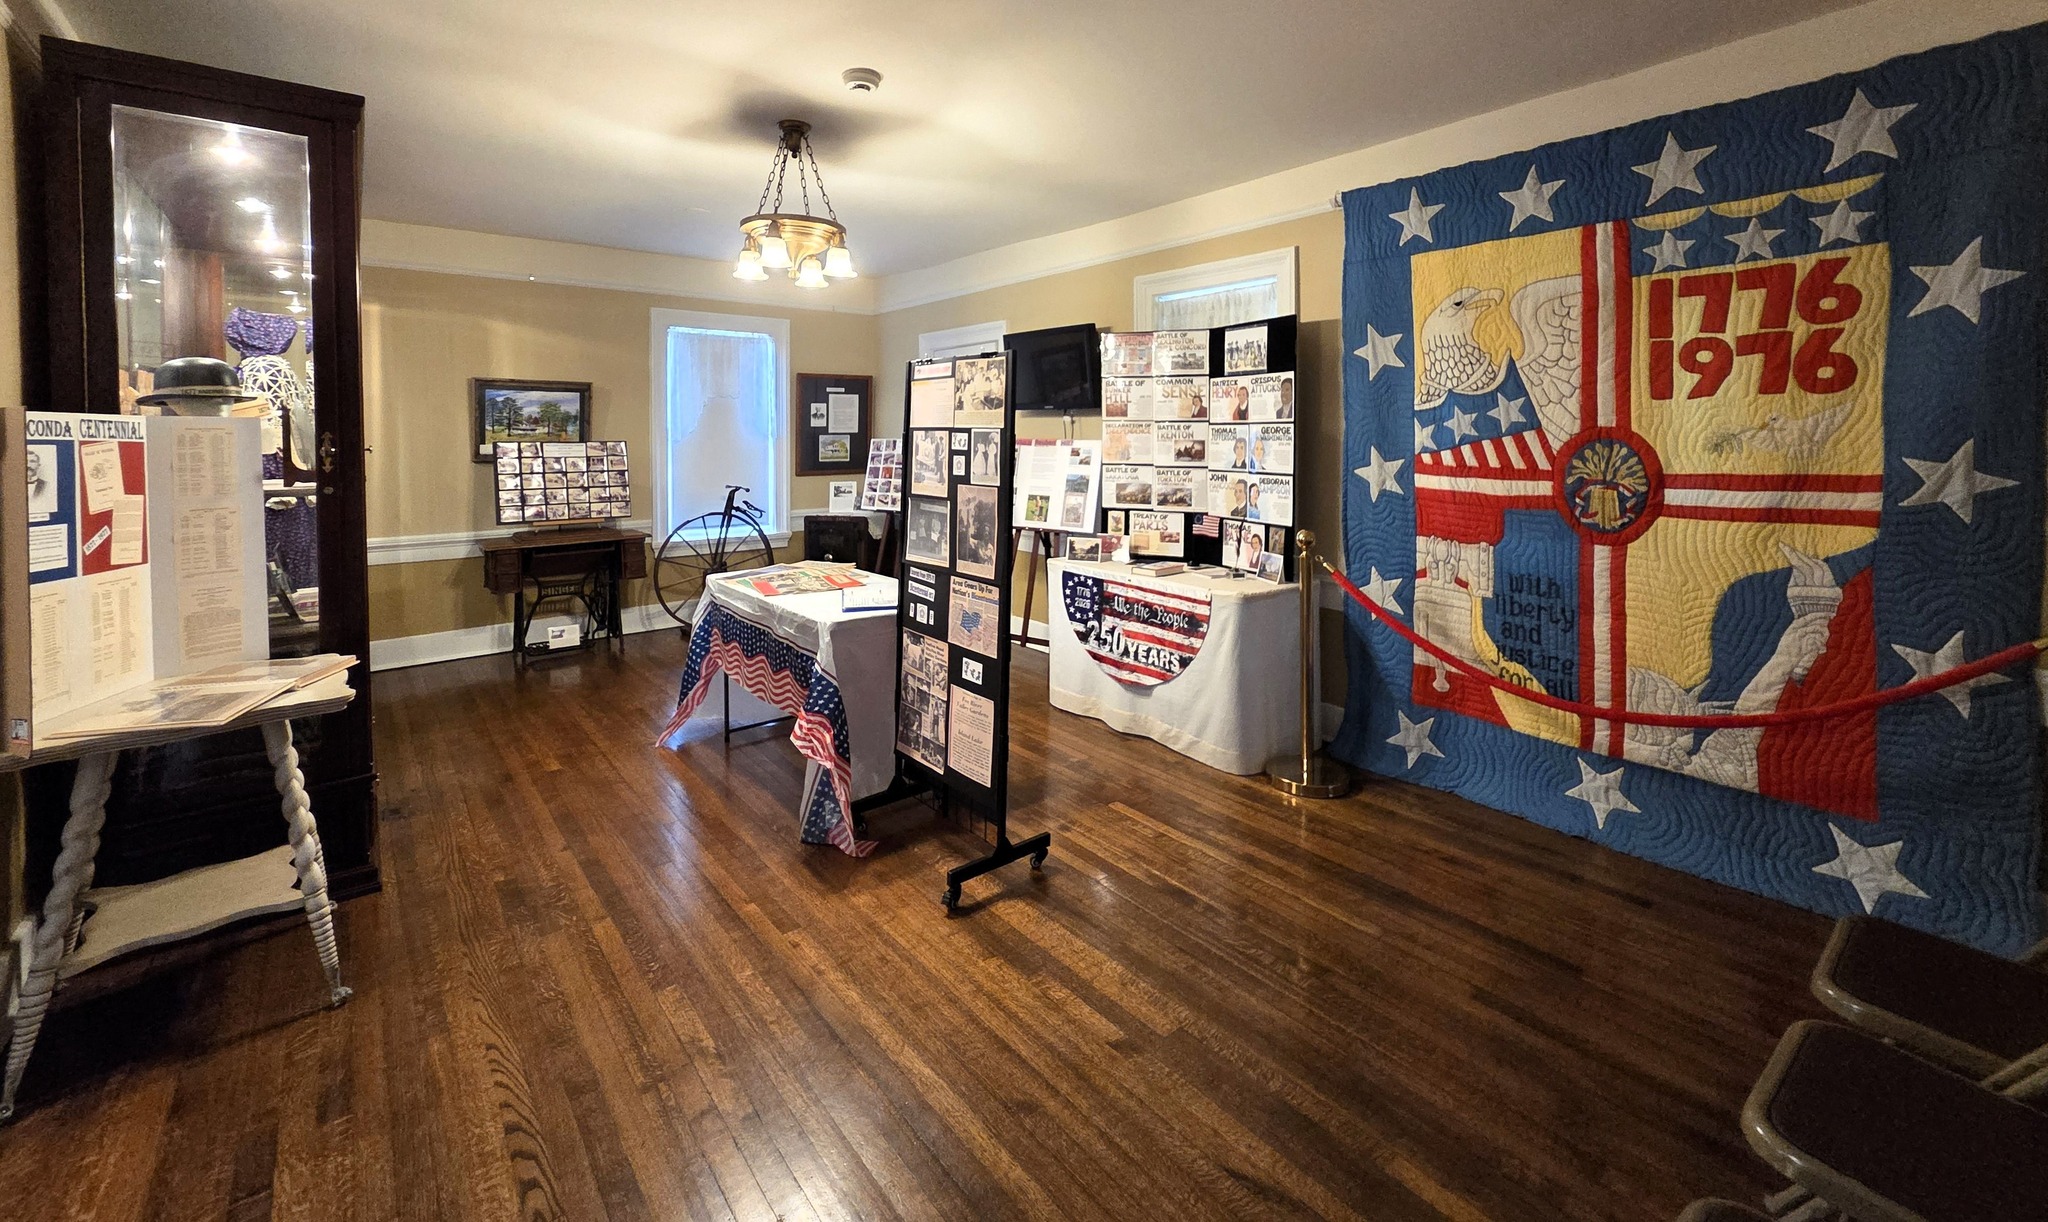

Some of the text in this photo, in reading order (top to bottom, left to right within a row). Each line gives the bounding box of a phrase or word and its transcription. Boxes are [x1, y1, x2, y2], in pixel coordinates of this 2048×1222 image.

[1648, 257, 1862, 338] 1776
[1648, 327, 1859, 401] 1976
[1155, 378, 1194, 386] COMMON
[1250, 376, 1281, 384] CRISPUS
[1105, 393, 1132, 403] HILL
[1162, 384, 1206, 398] SENSE
[1212, 386, 1238, 399] HENRY
[79, 418, 144, 439] CENTENNIAL
[1261, 426, 1291, 435] GEORGE
[1209, 473, 1228, 482] JOHN
[1259, 478, 1290, 486] DEBORAH
[1133, 520, 1169, 531] PARIS
[952, 578, 963, 587] Area
[978, 583, 985, 593] Up
[1076, 586, 1091, 598] 1776
[1508, 573, 1560, 599] with
[1074, 597, 1091, 609] 2026
[1113, 595, 1188, 630] We the People
[1494, 592, 1575, 634] liberty
[1501, 621, 1542, 646] and
[1086, 620, 1180, 672] 250 YEARS
[1490, 643, 1575, 675] justice
